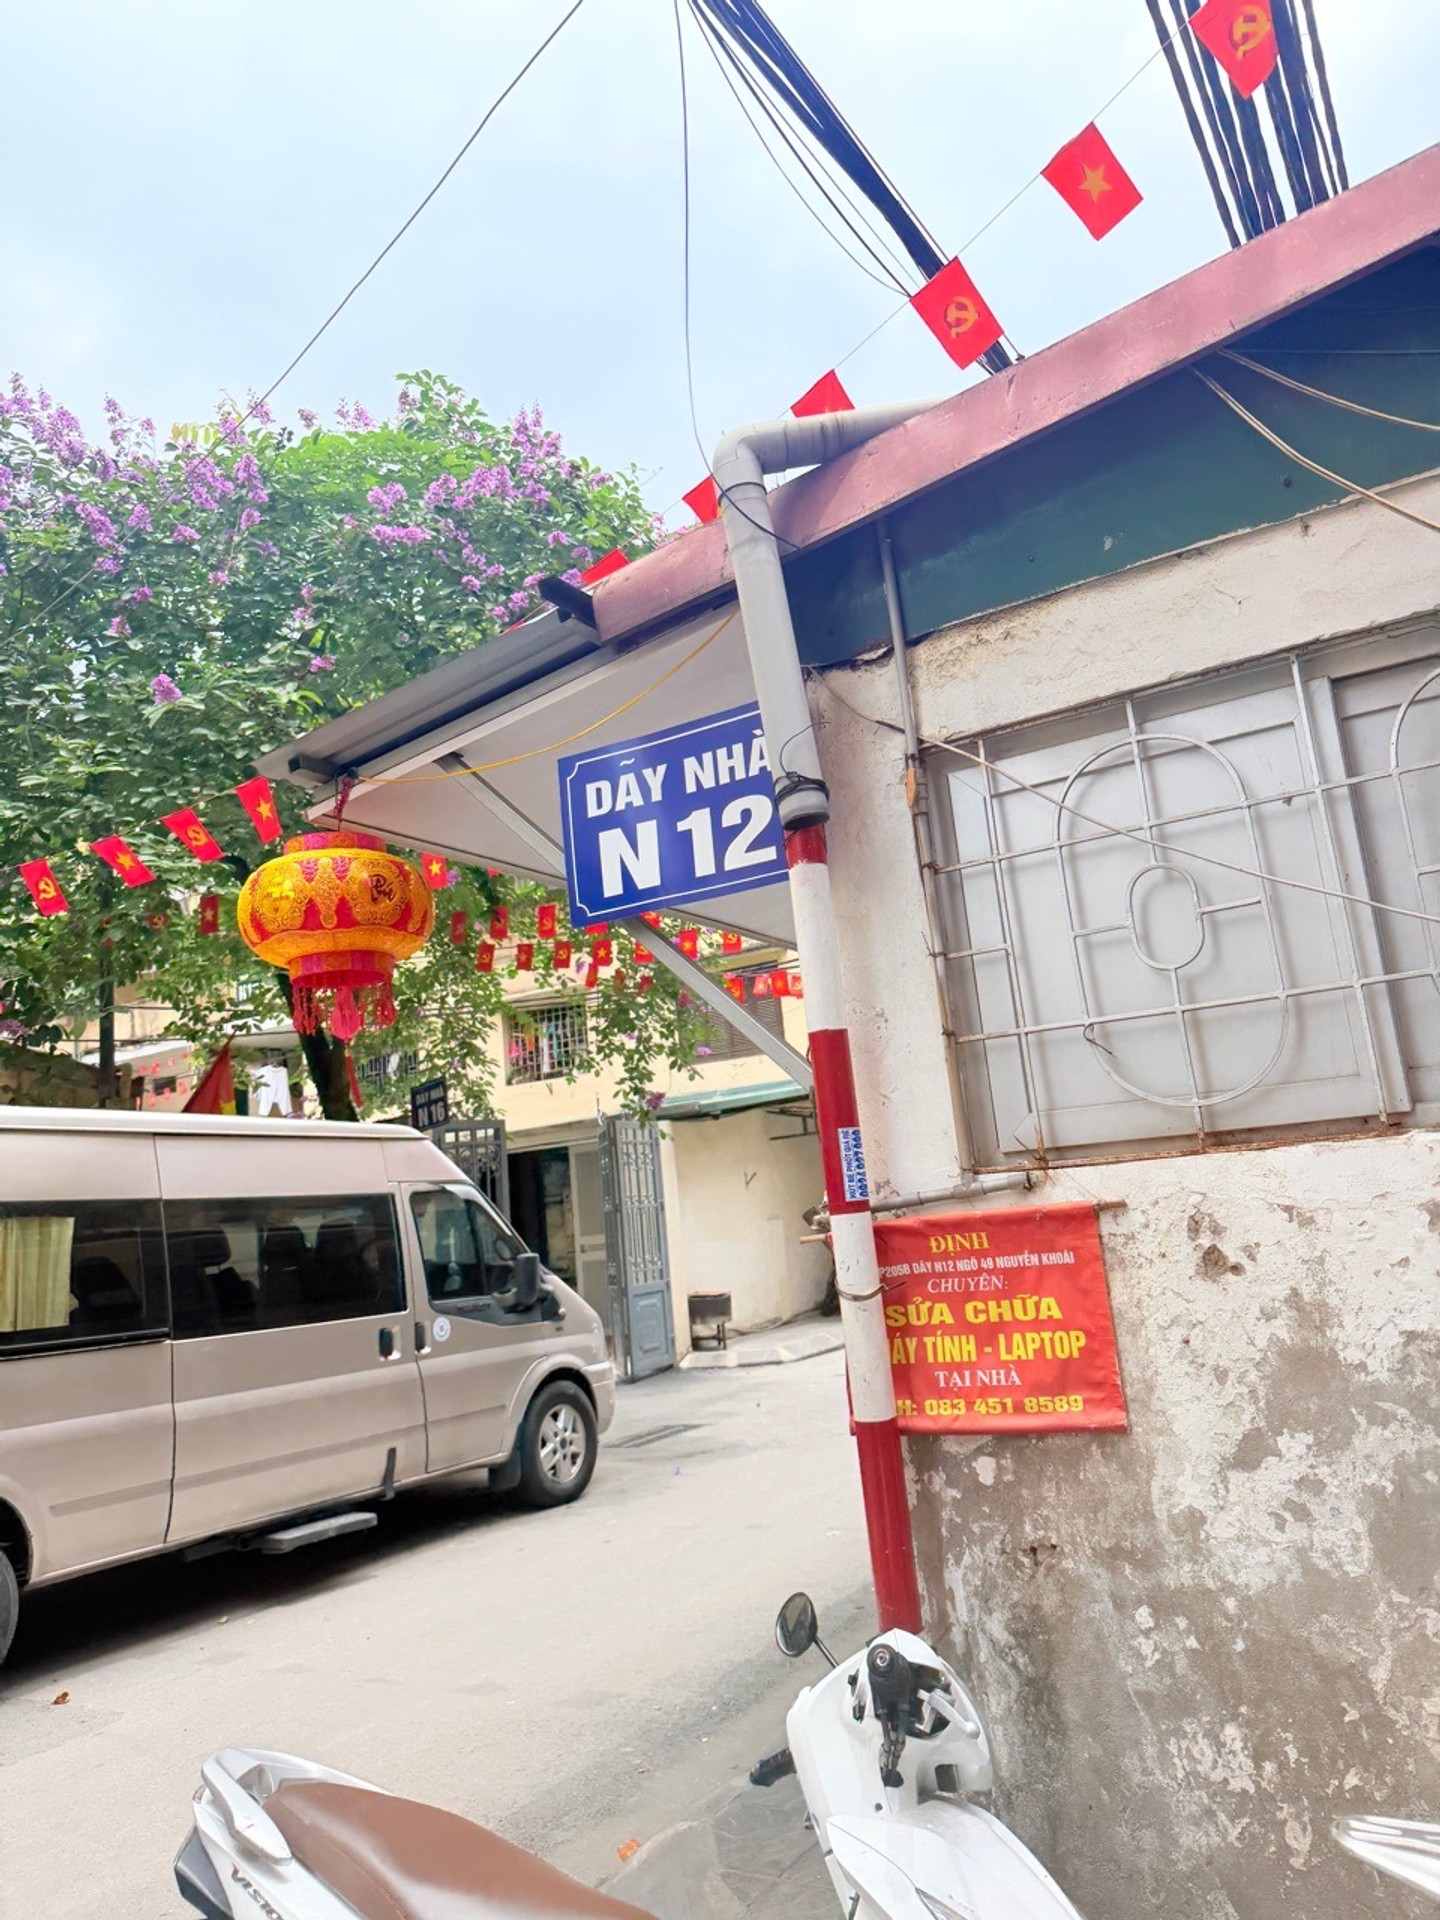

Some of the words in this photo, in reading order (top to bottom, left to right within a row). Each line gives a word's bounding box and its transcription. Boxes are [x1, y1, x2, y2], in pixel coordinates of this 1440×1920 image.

[586, 758, 667, 818] DÃY
[683, 729, 772, 793] NHÀ
[598, 819, 661, 898] N
[676, 795, 777, 878] 12
[430, 1101, 446, 1123] 16
[929, 1232, 990, 1256] ĐỊNH
[934, 1260, 955, 1273] N12
[981, 1257, 994, 1269] 49
[927, 1272, 1009, 1293] CHUYÊN:
[885, 1296, 954, 1327] SỬA
[965, 1293, 1063, 1322] CHỮA
[889, 1332, 917, 1364] ÁY
[923, 1330, 977, 1363] TÍNH
[999, 1330, 1087, 1361] LAPTOP
[934, 1370, 972, 1391] TẠI
[977, 1364, 1022, 1386] NHÀ
[897, 1399, 918, 1415] H:
[924, 1398, 966, 1415] 083
[973, 1397, 1014, 1414] 451
[1024, 1395, 1084, 1413] 8589
